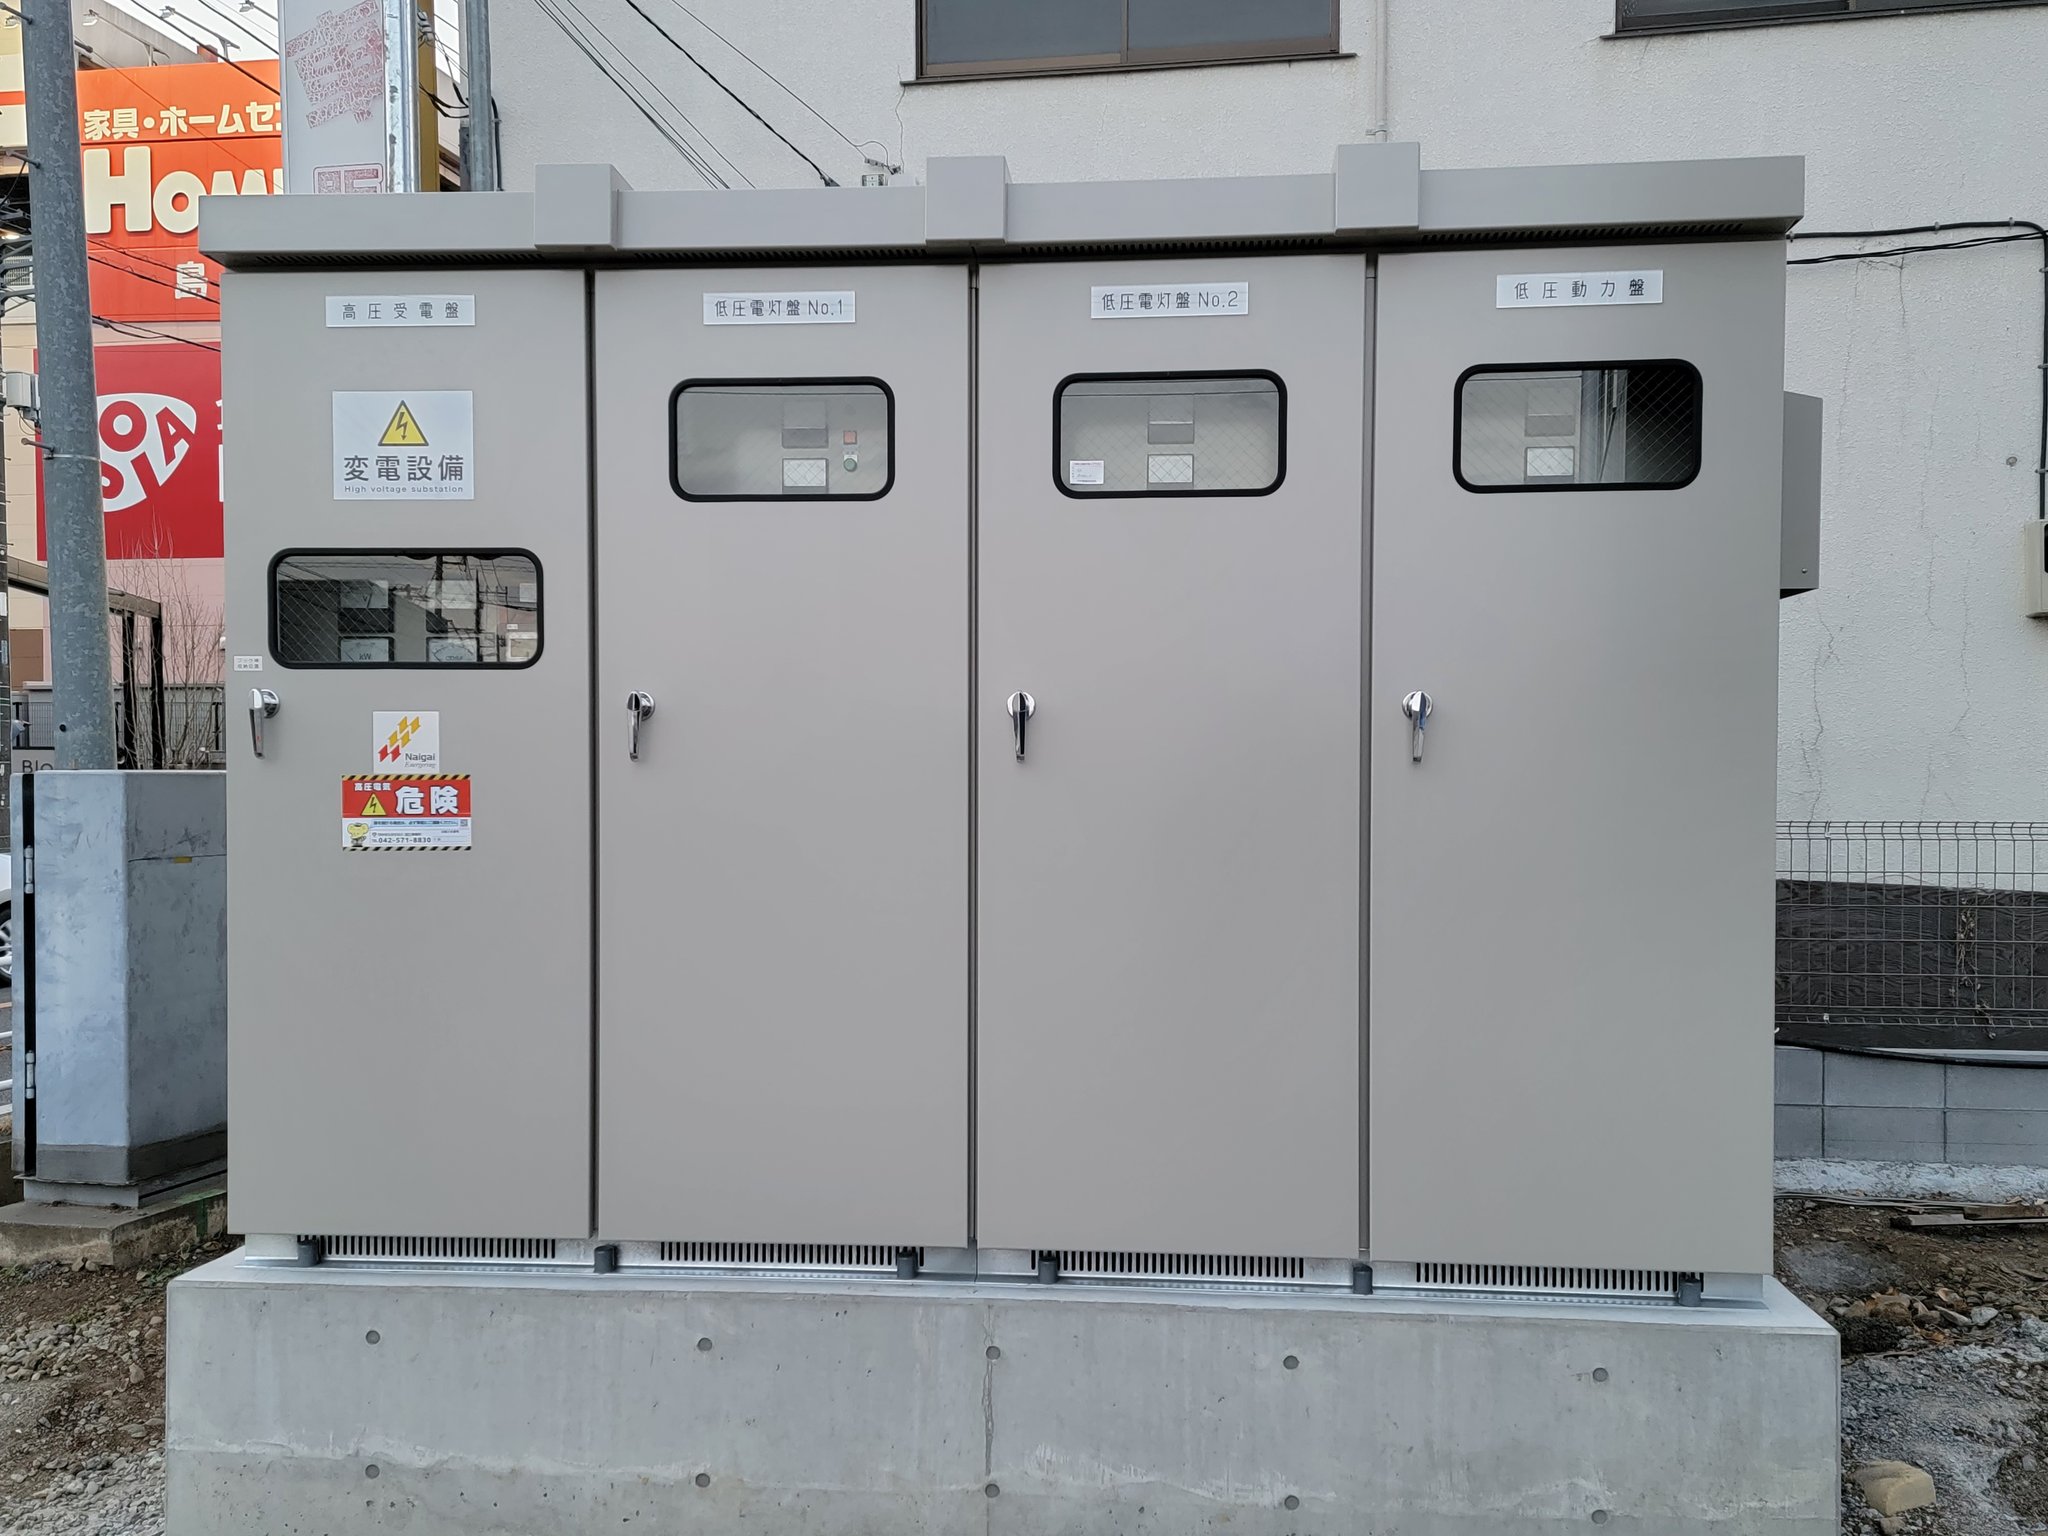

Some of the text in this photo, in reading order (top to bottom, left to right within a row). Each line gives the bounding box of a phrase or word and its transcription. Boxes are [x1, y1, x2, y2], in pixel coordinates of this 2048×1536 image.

[83, 102, 281, 140] 家具・ホームセ
[175, 261, 208, 299] 島
[1514, 278, 1644, 300] 低圧動力盤
[342, 302, 459, 320] 高圧受電盤
[344, 455, 464, 482] 変電設備
[344, 485, 463, 494] High voltage substation
[405, 753, 436, 763] Naigai
[395, 785, 459, 815] 危険
